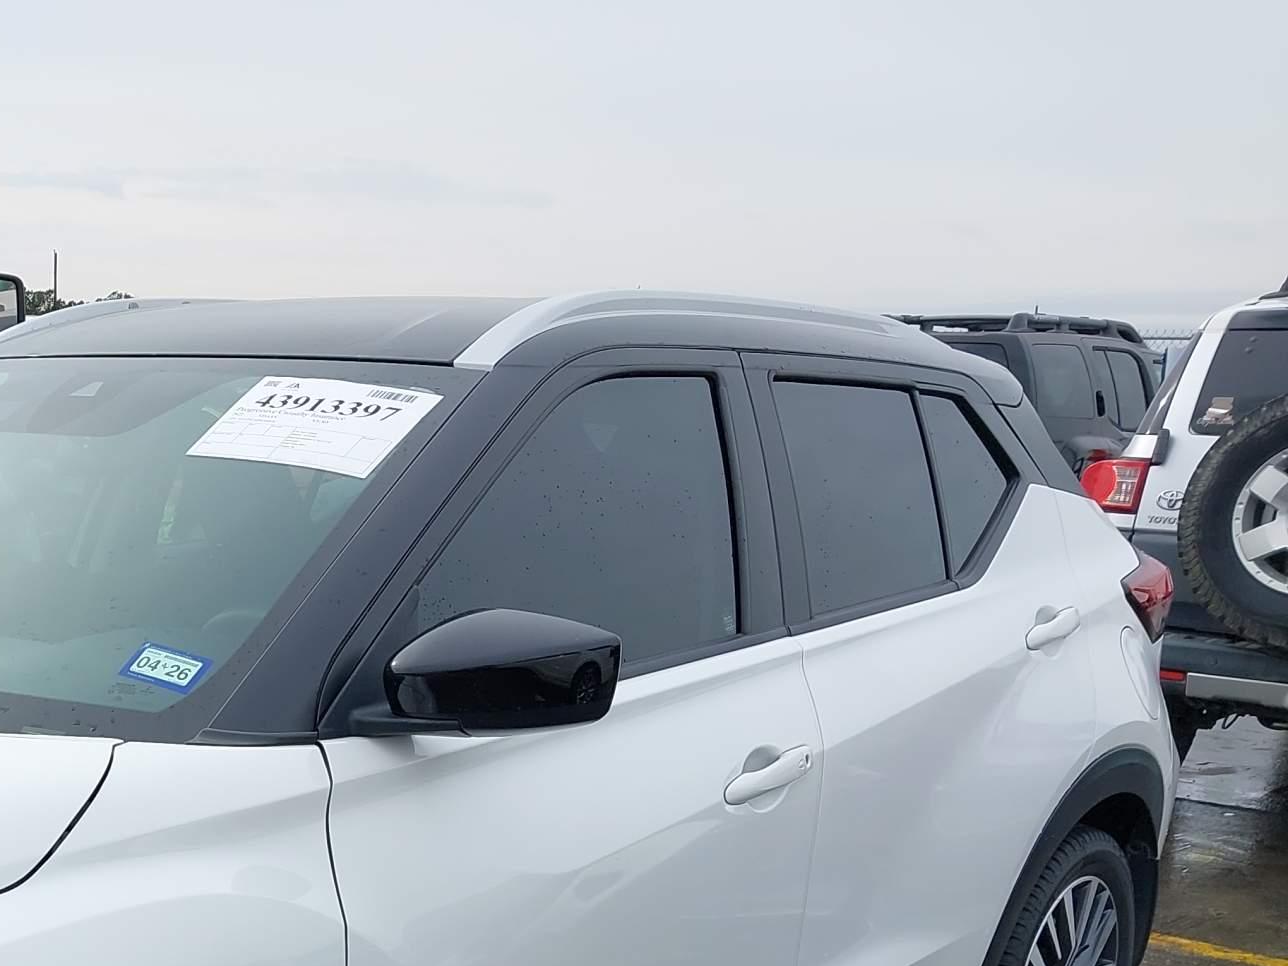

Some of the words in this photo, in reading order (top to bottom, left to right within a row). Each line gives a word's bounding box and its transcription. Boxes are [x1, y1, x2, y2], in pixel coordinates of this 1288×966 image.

[255, 393, 403, 421] 43913397
[1148, 515, 1179, 525] TOYO
[136, 656, 161, 671] 04
[165, 663, 192, 681] 26
